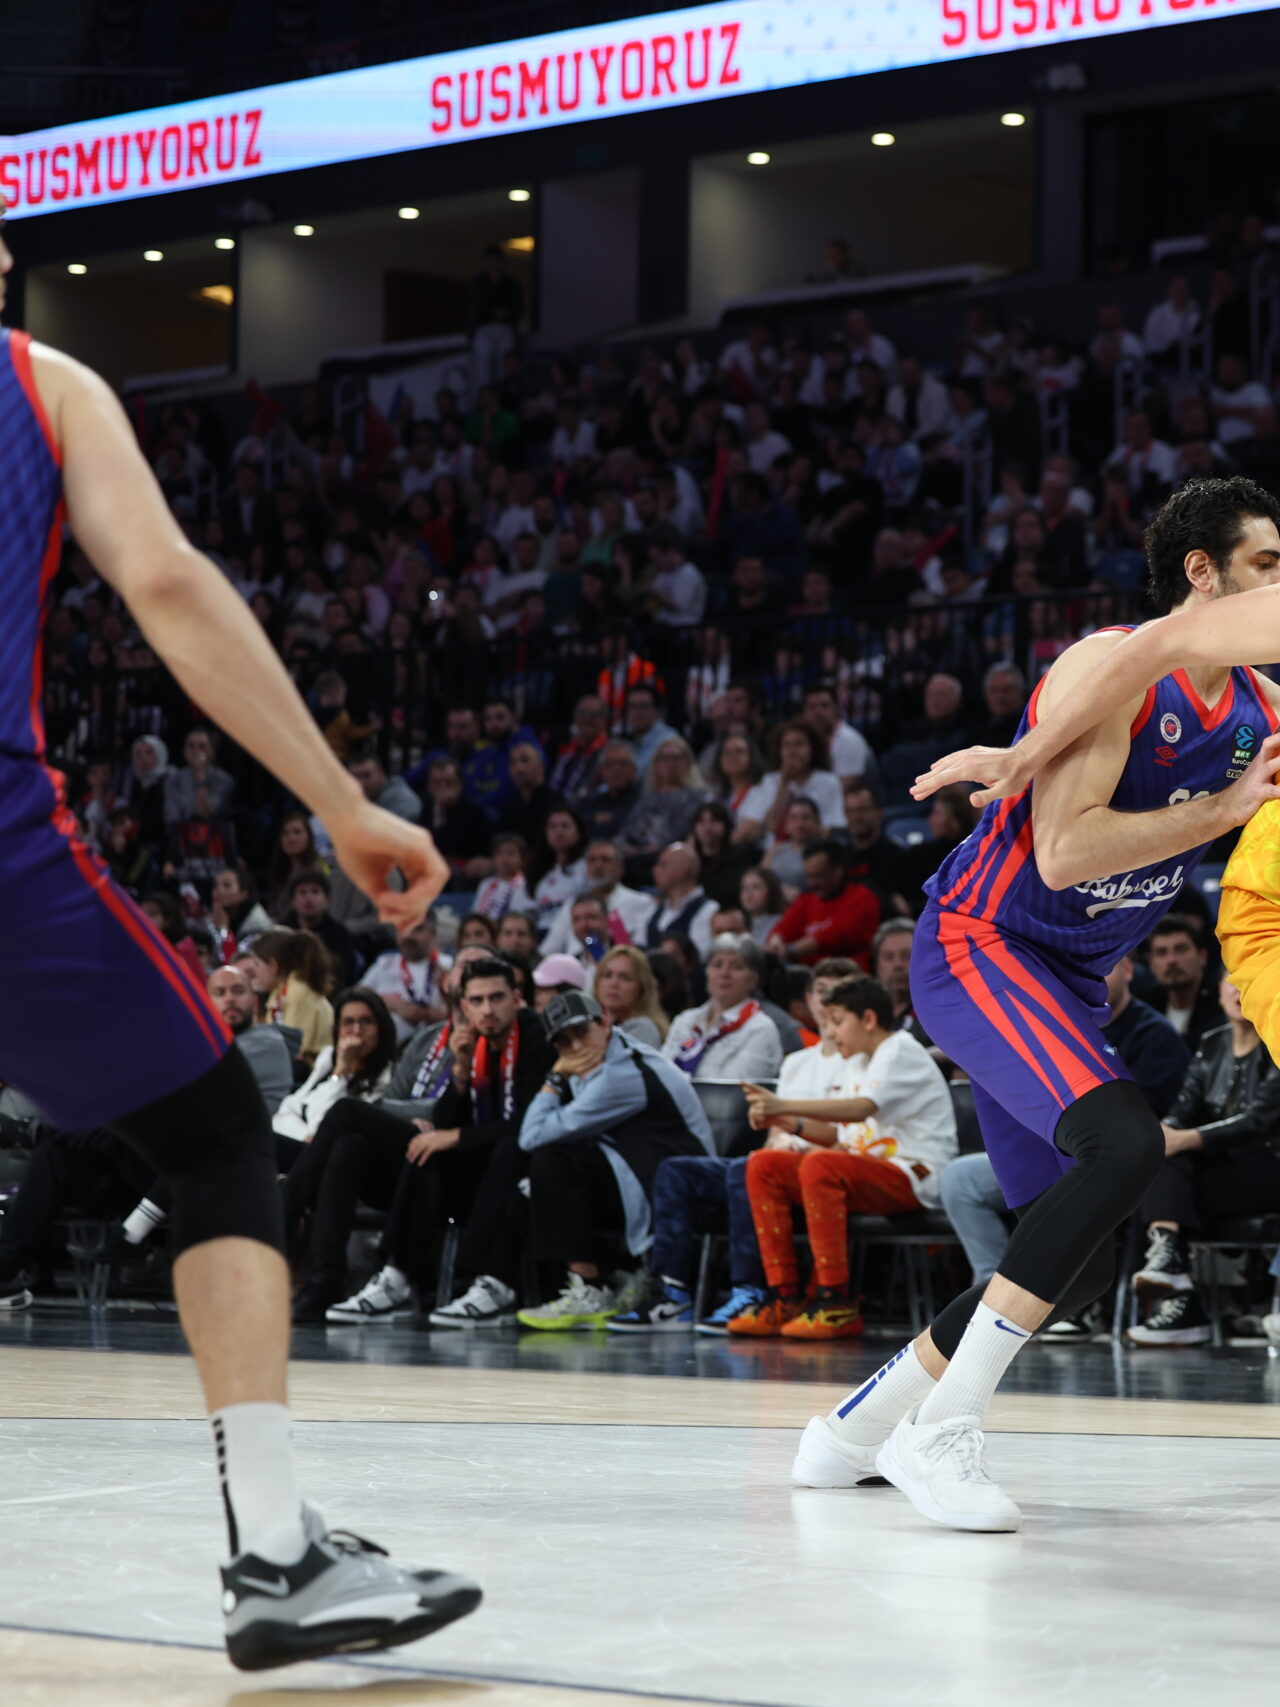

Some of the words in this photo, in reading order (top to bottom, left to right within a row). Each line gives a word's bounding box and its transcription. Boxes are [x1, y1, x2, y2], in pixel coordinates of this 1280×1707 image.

[431, 22, 741, 133] SUSMUYORUZ
[0, 109, 262, 208] SUSMUYORUZ
[1234, 750, 1251, 759] BKT
